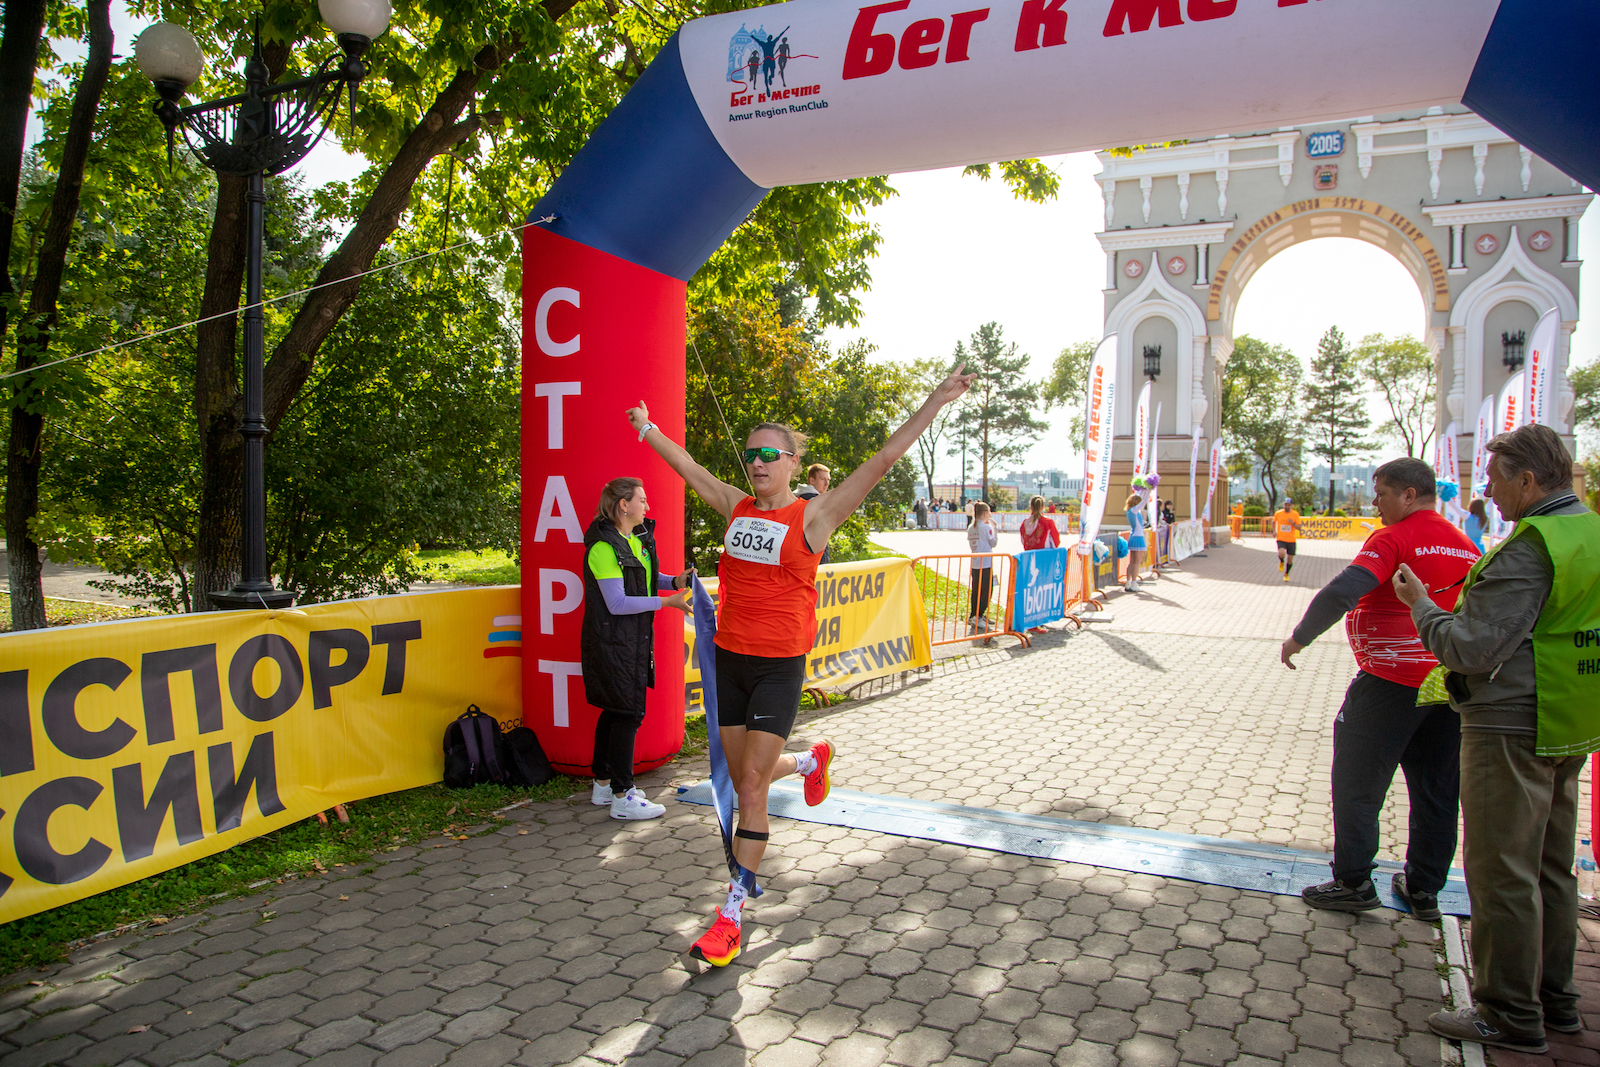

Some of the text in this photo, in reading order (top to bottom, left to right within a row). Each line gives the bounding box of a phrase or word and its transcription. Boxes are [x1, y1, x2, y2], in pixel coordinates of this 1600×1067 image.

[842, 0, 990, 80] Бег
[1014, 0, 1068, 52] к
[730, 84, 821, 107] Бег к мечте
[728, 100, 829, 122] Amur Region RunClub
[1310, 134, 1341, 155] 2005
[1099, 382, 1115, 492] Amur Region RunClub
[534, 286, 584, 727] СТАРТ
[1300, 529, 1339, 538] РОССИИ
[1301, 520, 1353, 530] МИНСПОРТ
[731, 531, 775, 554] 5034
[804, 635, 916, 684] ТЛЕТИКИ
[0, 730, 287, 899] СИИ
